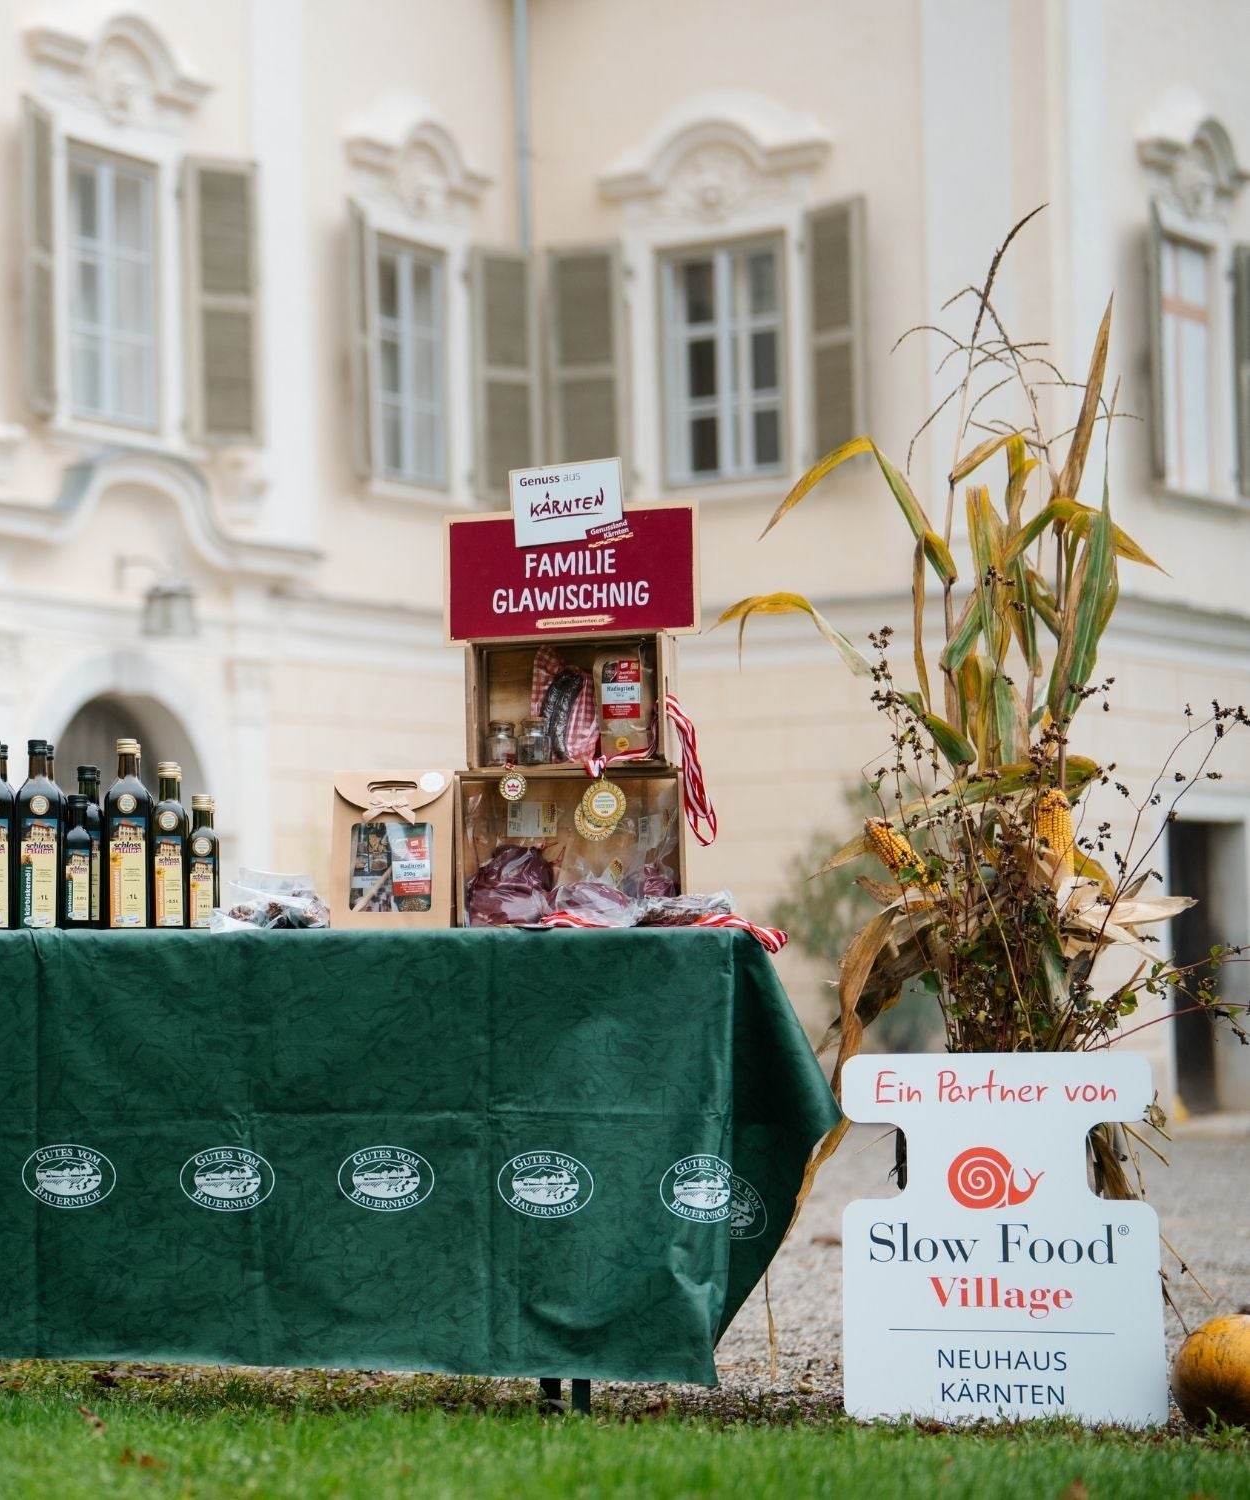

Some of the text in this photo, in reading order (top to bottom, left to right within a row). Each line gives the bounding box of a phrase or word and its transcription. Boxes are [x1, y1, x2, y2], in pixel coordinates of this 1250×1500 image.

[519, 472, 581, 487] Genuss aus
[590, 519, 628, 535] Genussland
[603, 527, 630, 539] Kärnten
[525, 548, 617, 579] FAMILIE
[492, 580, 650, 614] GLAWISCHNIG
[24, 870, 32, 916] kürbiskernöl
[875, 1069, 1117, 1103] Ein Partner von
[36, 1148, 102, 1166] GUTES VOM
[194, 1150, 261, 1168] GUTES VOM
[352, 1150, 420, 1168] GUTES VOM
[512, 1154, 579, 1173] GUTES VOM
[674, 1158, 731, 1179] GUTES VOM
[32, 1184, 101, 1206] BAUERNHOF
[191, 1188, 260, 1209] BAUERNHOF
[349, 1188, 420, 1209] BAUERNHOF
[509, 1192, 578, 1216] BAUERNHOF
[744, 1187, 762, 1210] VOM
[669, 1198, 729, 1221] BAUERNHOF
[869, 1222, 980, 1263] Slow
[927, 1276, 1074, 1319] Village
[937, 1349, 1067, 1371] NEUHAUS
[940, 1378, 1065, 1405] KÄRNTEN
